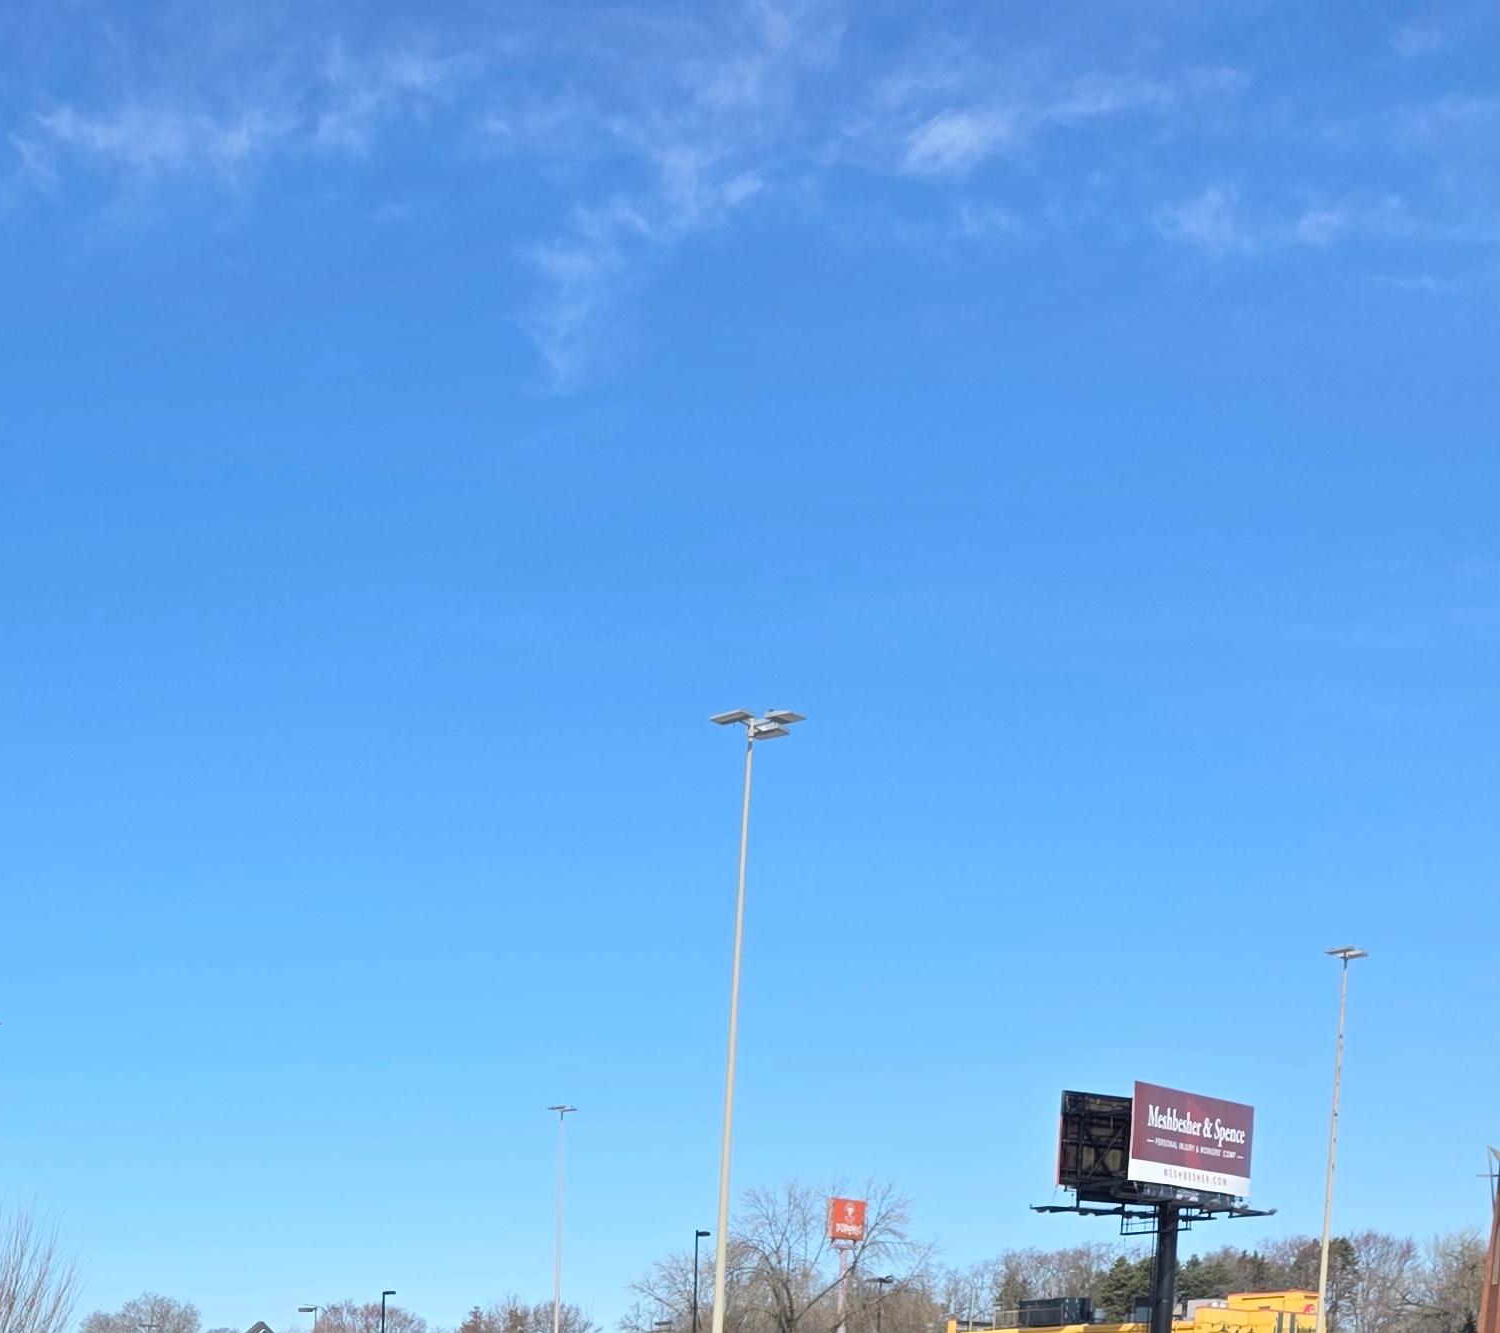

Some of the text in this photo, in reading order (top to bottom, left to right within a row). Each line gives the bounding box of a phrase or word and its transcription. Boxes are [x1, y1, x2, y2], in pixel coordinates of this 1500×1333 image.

[1147, 1104, 1246, 1148] Meshbesher & Spence
[1155, 1137, 1178, 1150] PERSONAL
[1179, 1142, 1195, 1153] INJURY
[1164, 1168, 1227, 1186] MESHBESHER.COM
